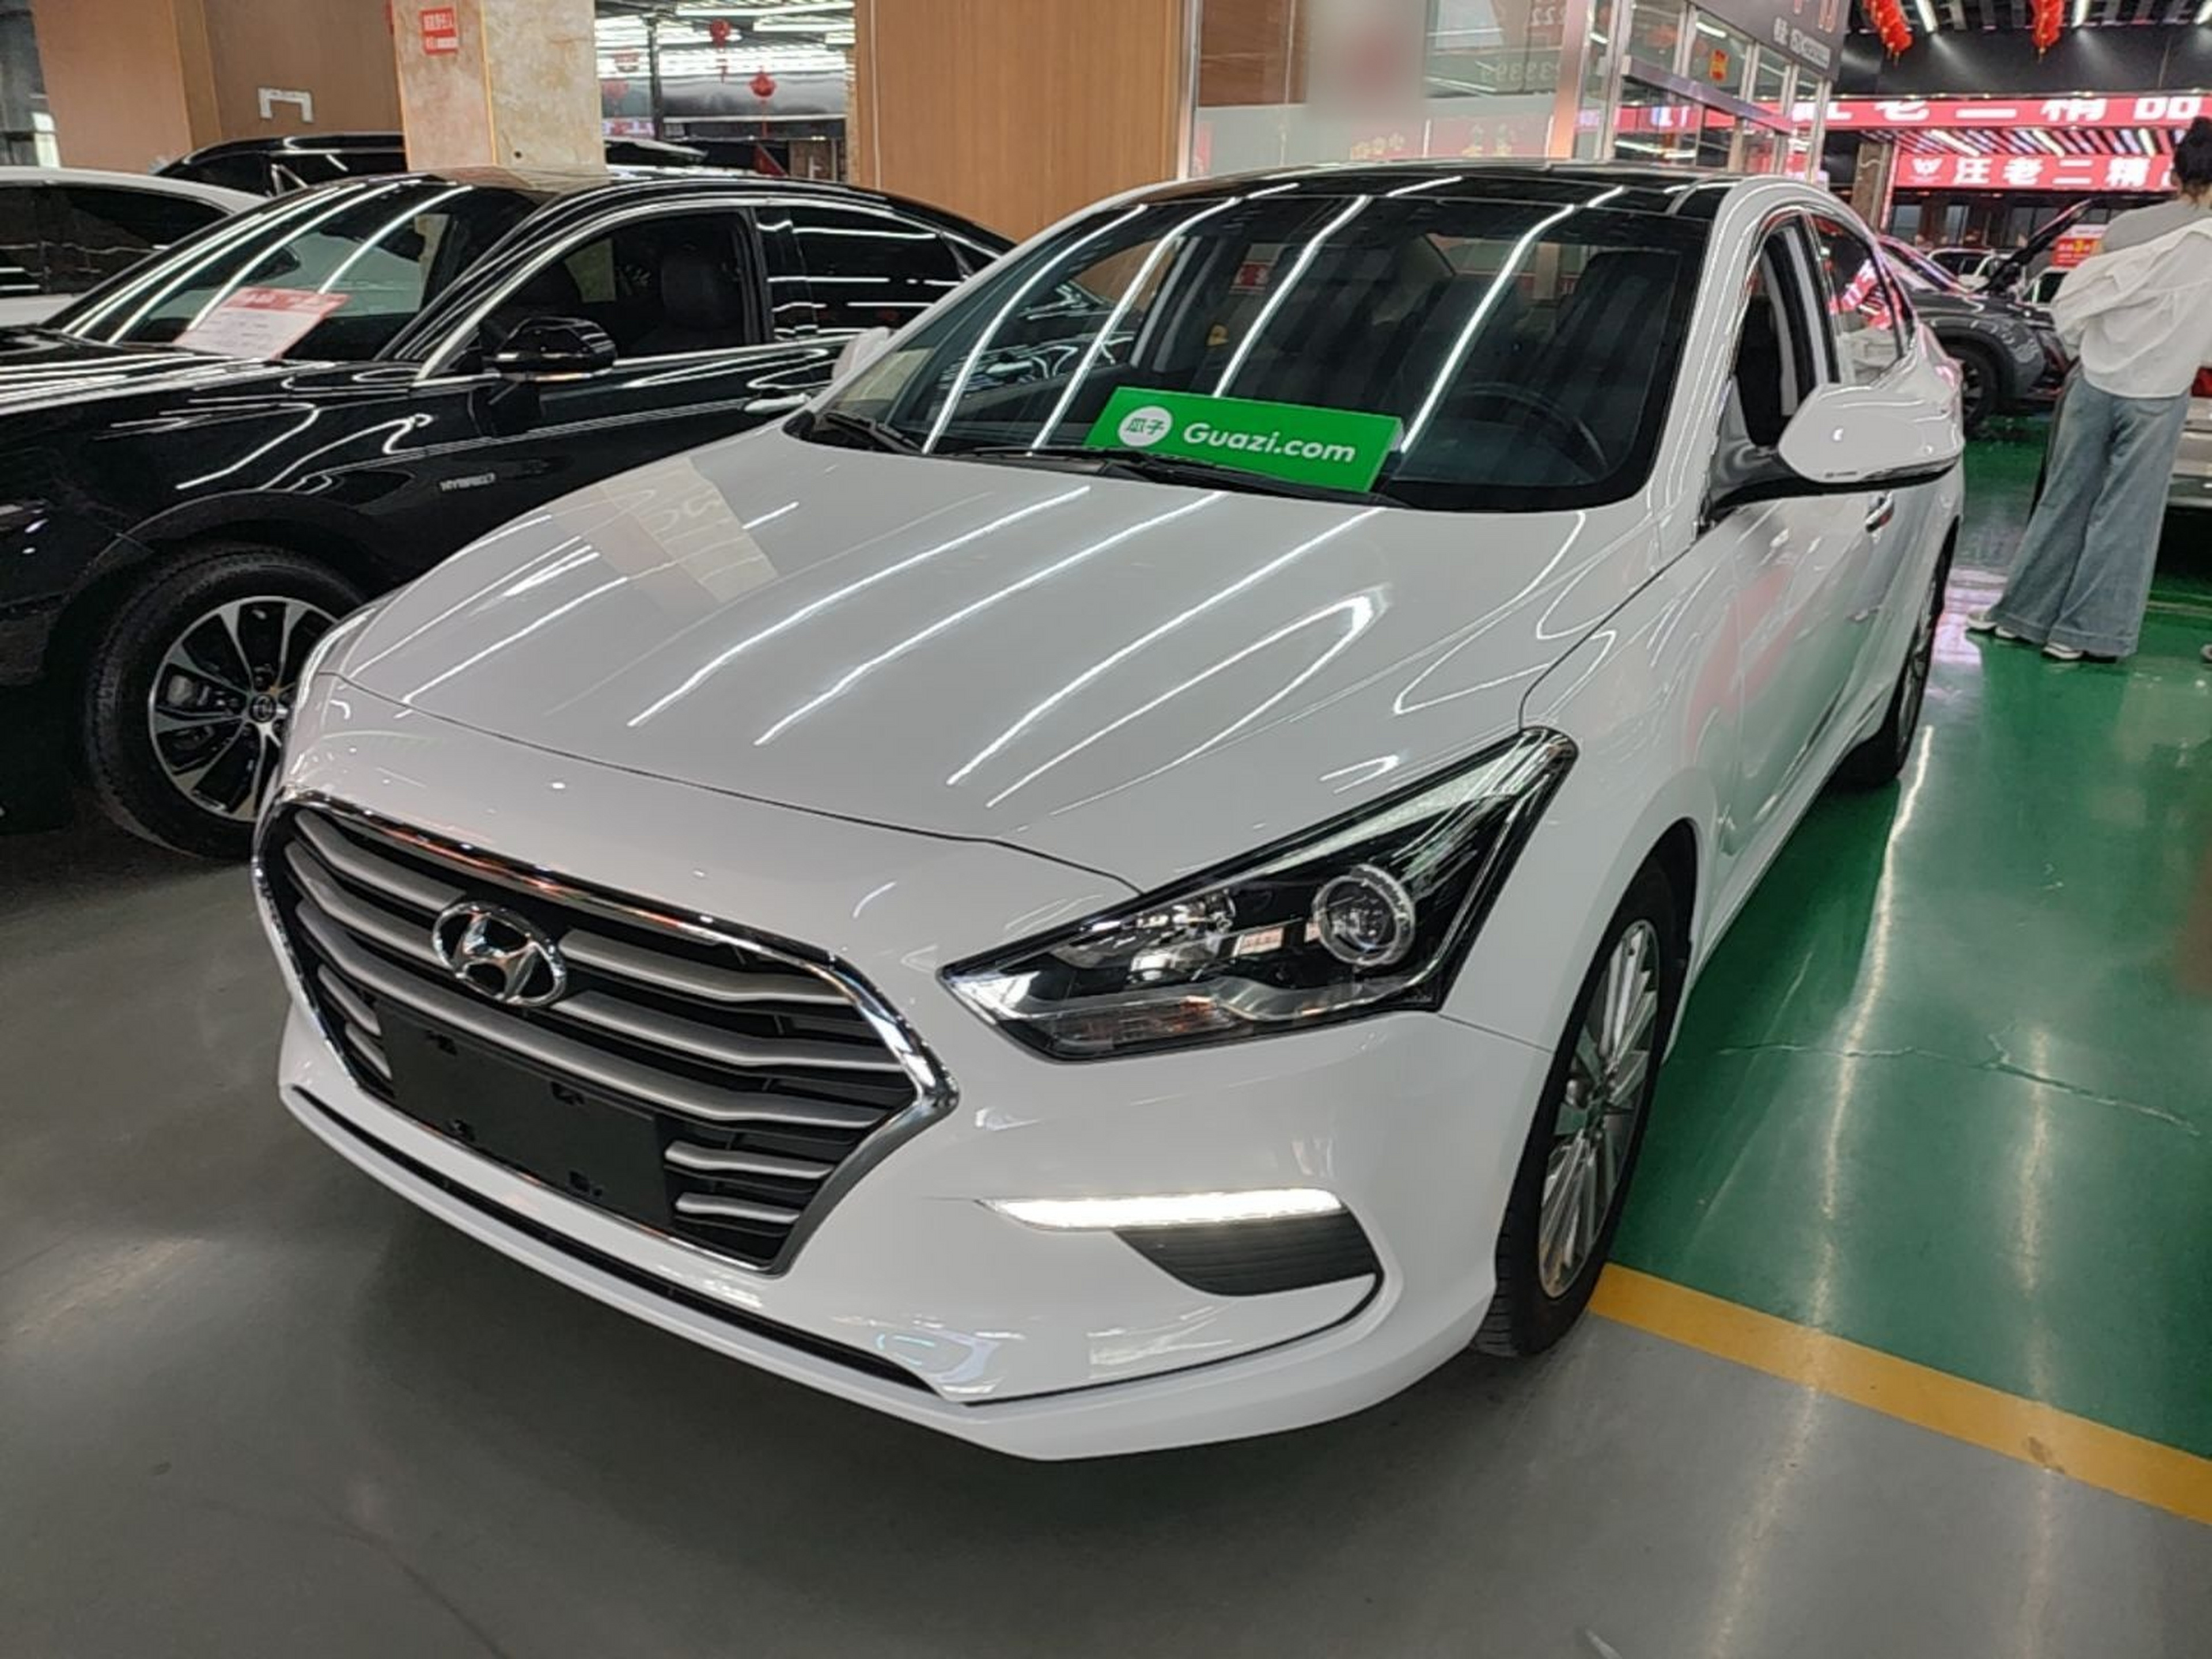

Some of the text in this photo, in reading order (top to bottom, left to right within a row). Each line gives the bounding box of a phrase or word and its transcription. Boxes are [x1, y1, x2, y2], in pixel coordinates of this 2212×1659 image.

[1952, 157, 2175, 187] 汪老二精
[1183, 422, 1355, 462] Guazi.com
